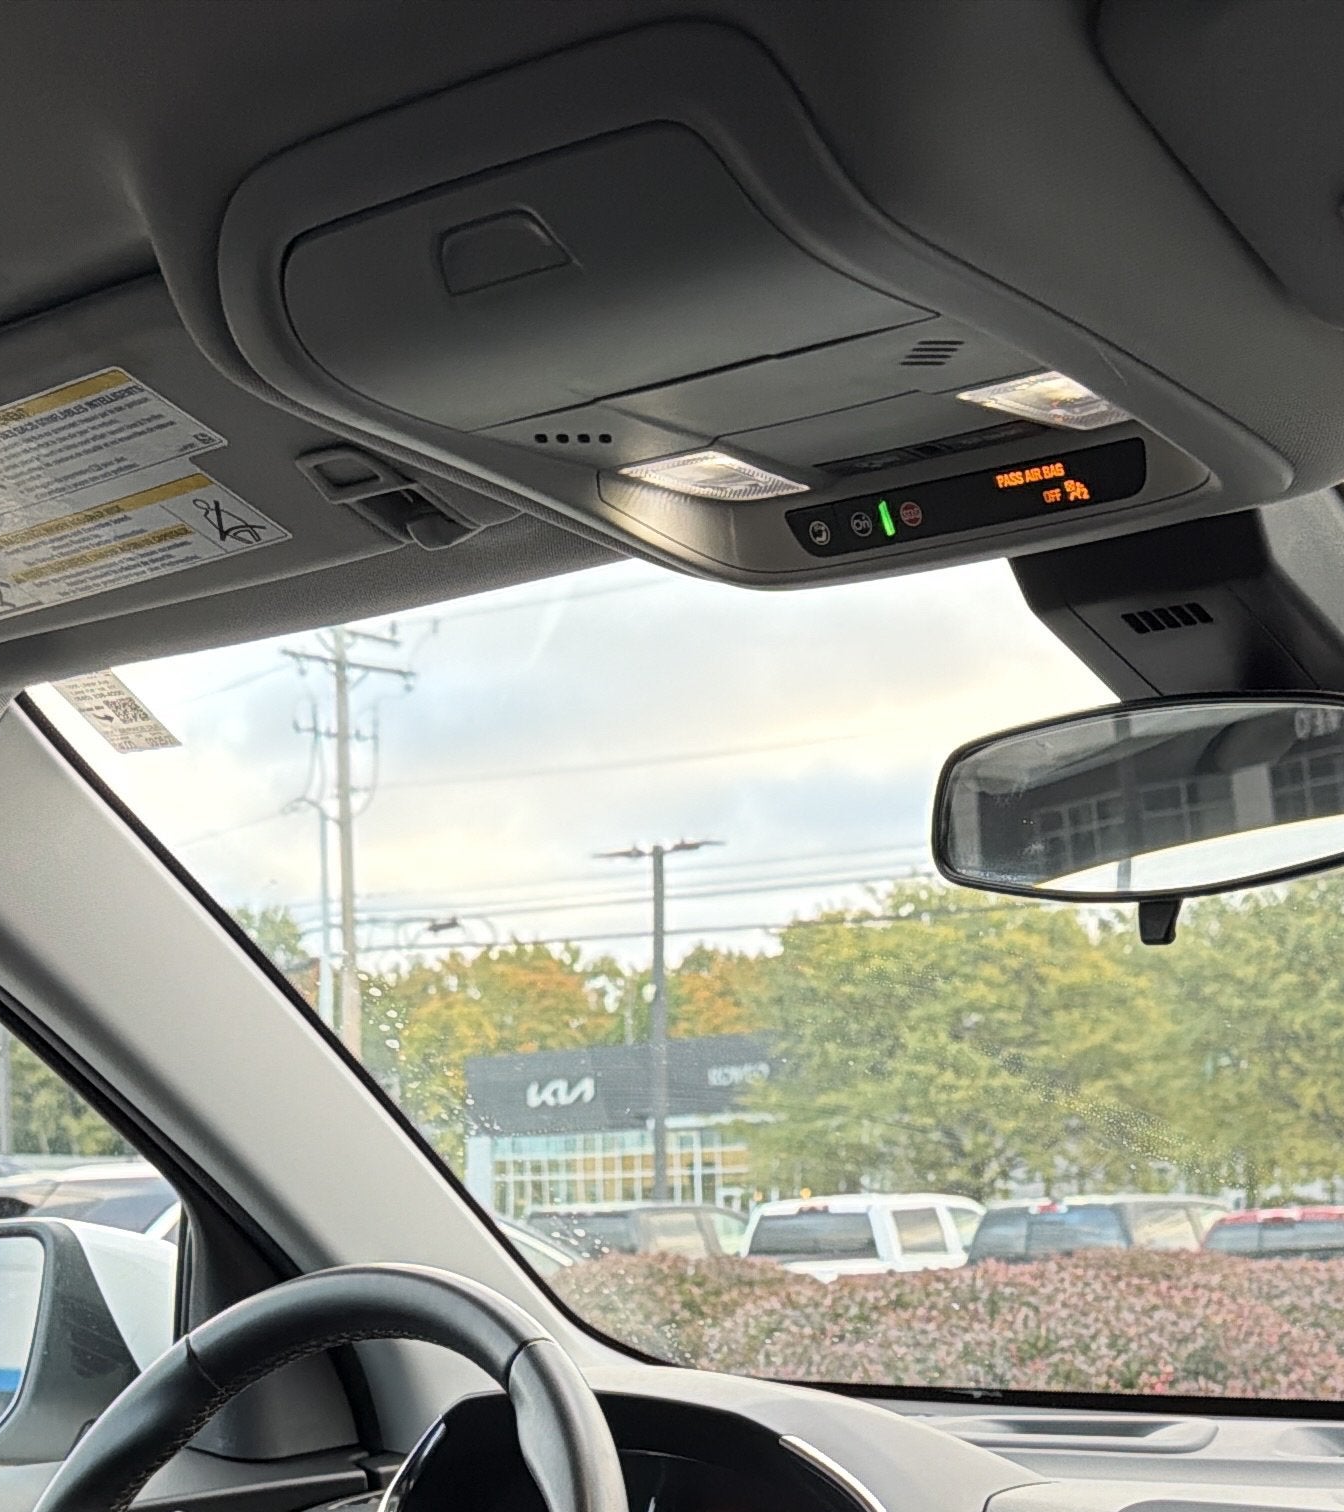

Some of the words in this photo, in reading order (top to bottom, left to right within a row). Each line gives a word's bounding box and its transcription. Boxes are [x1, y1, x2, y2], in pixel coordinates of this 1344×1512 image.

[996, 471, 1024, 488] PASS
[1024, 467, 1043, 483] AIR
[1042, 462, 1065, 479] BAG
[1042, 488, 1061, 503] OFF
